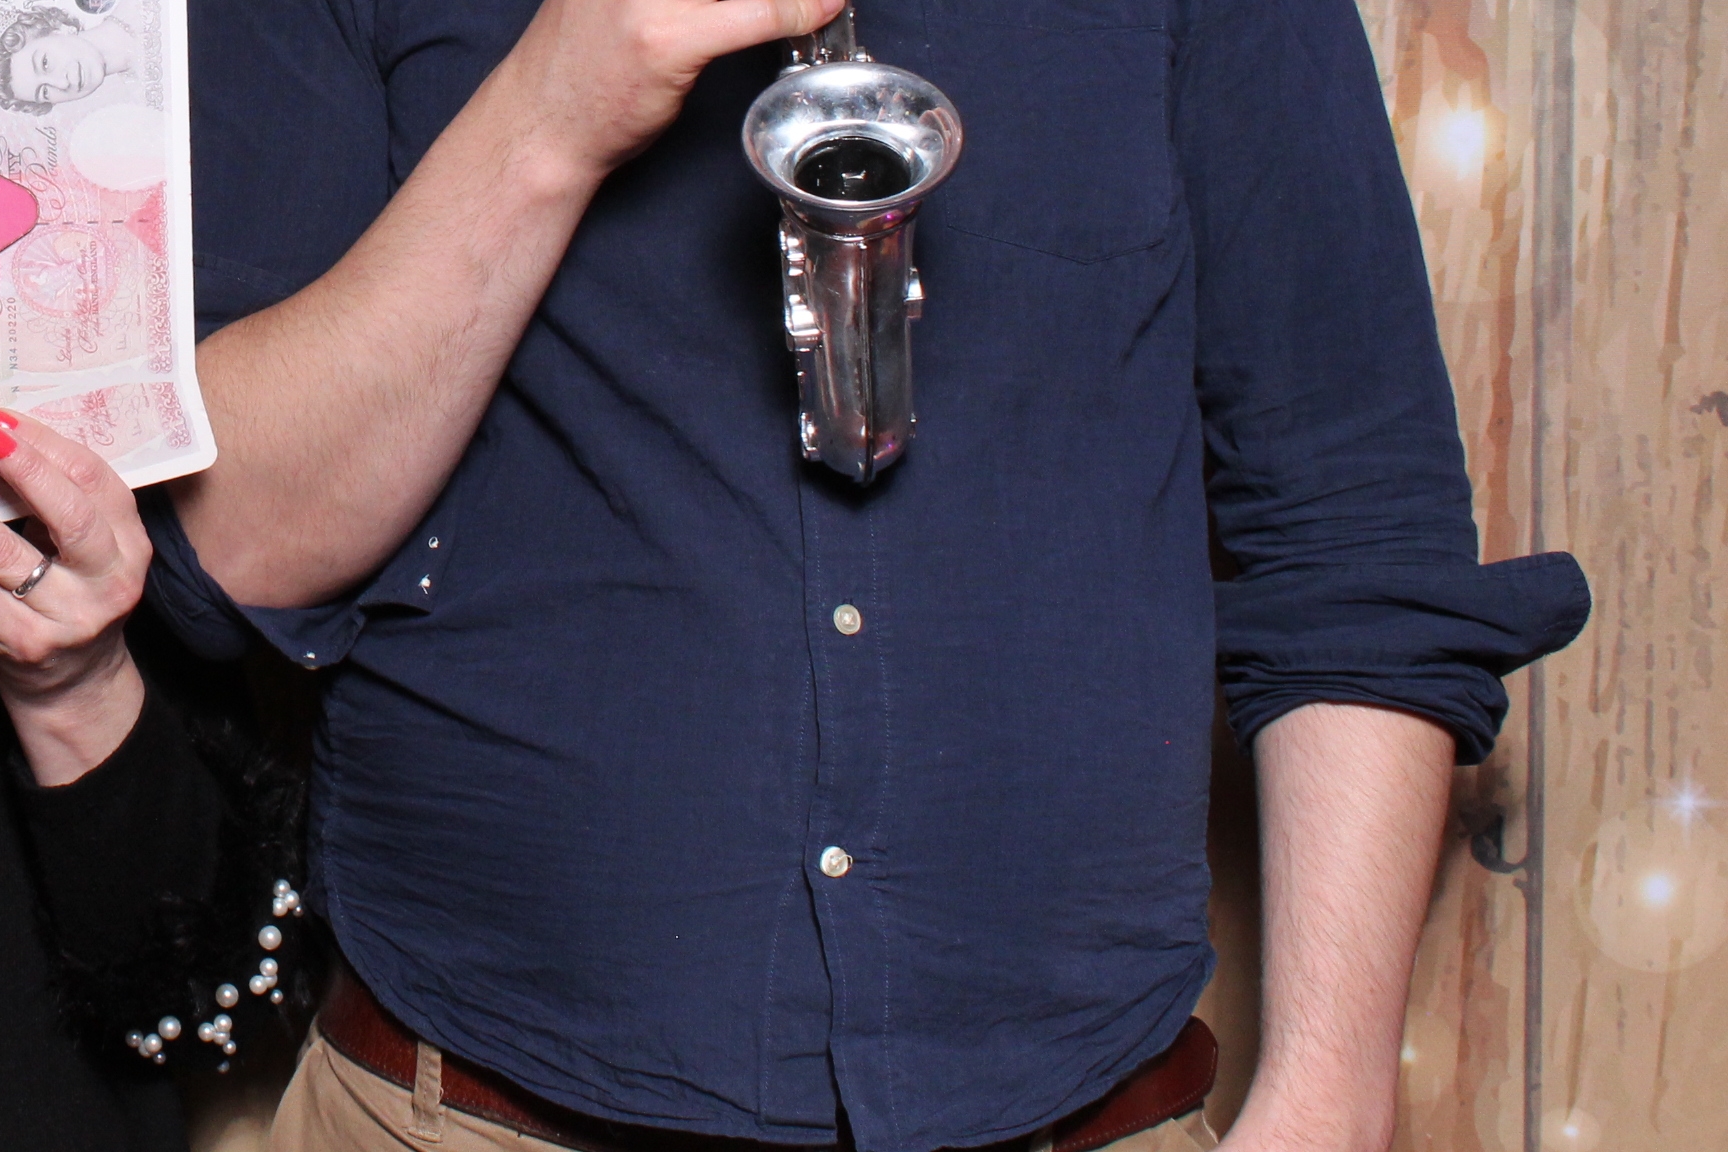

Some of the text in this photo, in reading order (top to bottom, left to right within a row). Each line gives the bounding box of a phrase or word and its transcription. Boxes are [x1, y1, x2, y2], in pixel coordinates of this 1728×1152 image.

[22, 126, 66, 223] Pounds
[7, 297, 18, 370] N34 202220
